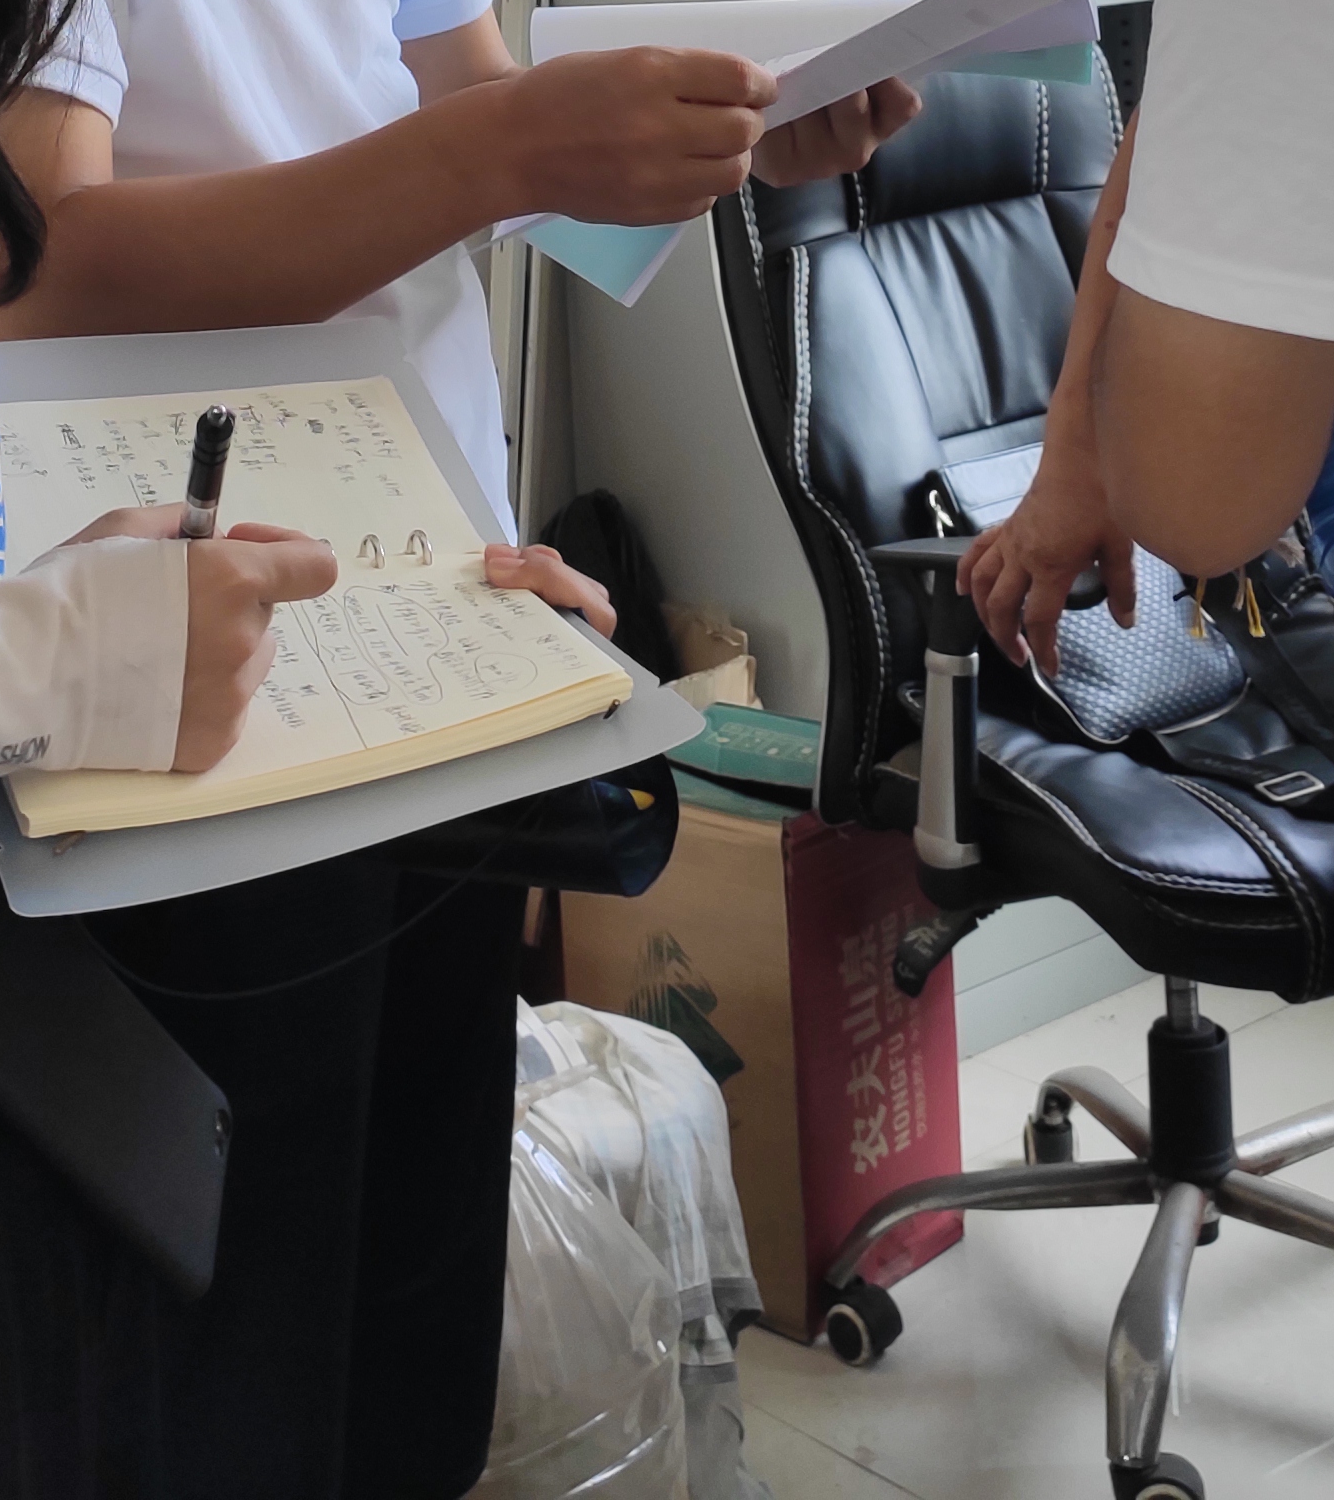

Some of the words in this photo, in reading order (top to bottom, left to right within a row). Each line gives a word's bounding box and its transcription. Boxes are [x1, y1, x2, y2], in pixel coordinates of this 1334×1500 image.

[838, 924, 890, 1174] 农夫山泉
[887, 1031, 912, 1152] NONGFU
